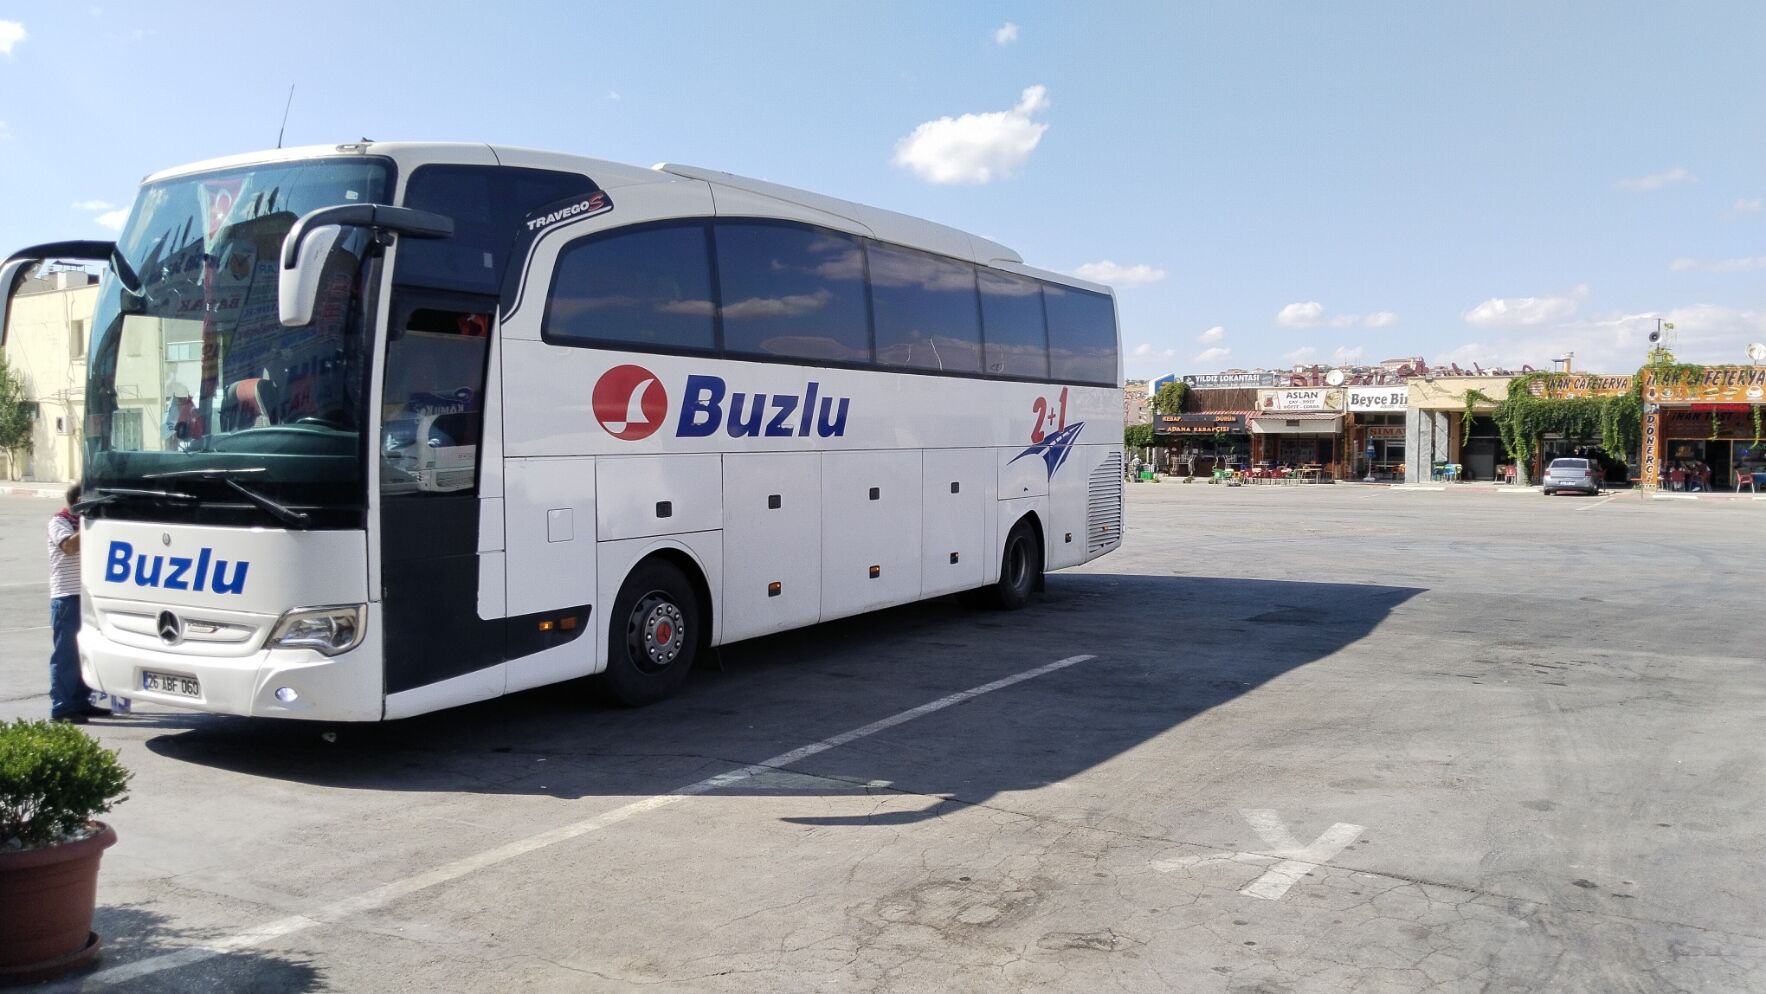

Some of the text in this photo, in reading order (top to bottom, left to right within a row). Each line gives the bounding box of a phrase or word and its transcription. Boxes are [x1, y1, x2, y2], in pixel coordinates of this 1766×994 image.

[527, 201, 589, 230] TRAVEGO
[1219, 374, 1260, 382] LOKANTASI
[676, 375, 850, 438] Buzlu
[1286, 391, 1319, 399] ASLAN
[1350, 393, 1388, 407] Beyce
[1031, 386, 1068, 444] 2+1
[105, 540, 250, 595] Buzlu
[148, 675, 158, 689] 26
[162, 677, 178, 692] ABF
